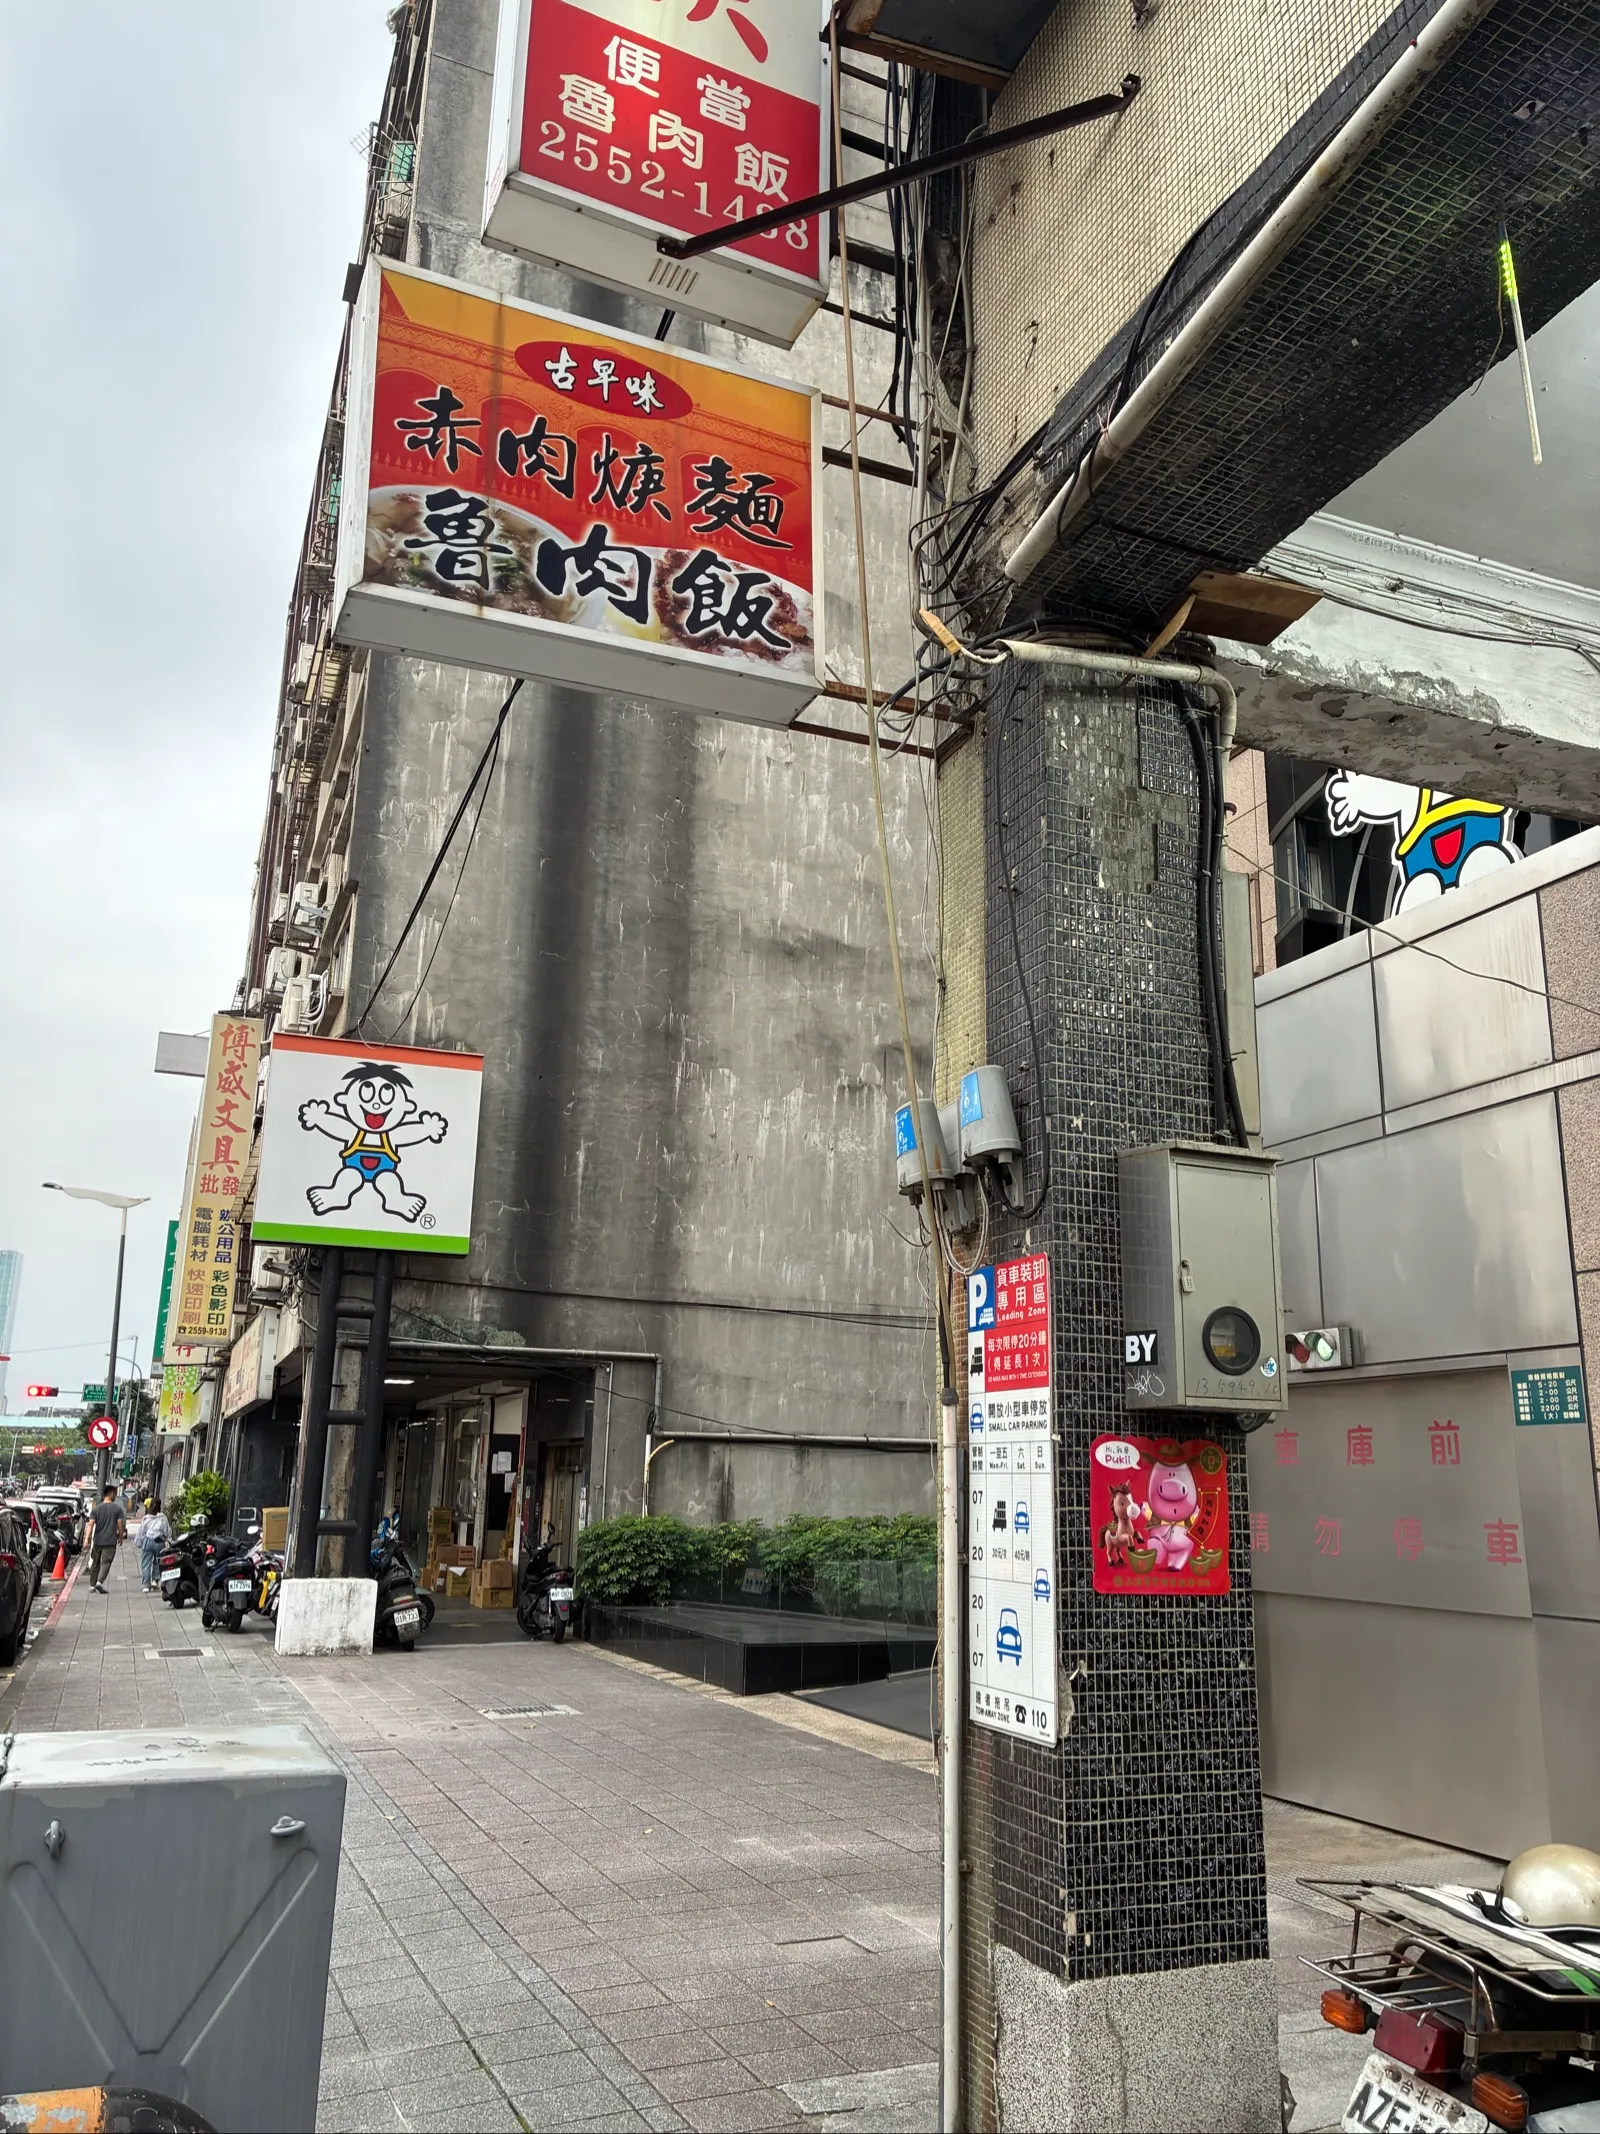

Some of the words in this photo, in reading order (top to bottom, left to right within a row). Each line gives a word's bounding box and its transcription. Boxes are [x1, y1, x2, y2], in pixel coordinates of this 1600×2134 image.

[603, 36, 751, 131] 便當
[559, 73, 790, 203] 魯肉飯
[545, 346, 665, 415] 古早味
[404, 488, 792, 648] 魯肉飯
[202, 1022, 257, 1173] 博威文具
[201, 1174, 240, 1196] 批發
[190, 1207, 213, 1263] 電腦耗材
[997, 1259, 1045, 1288] 貨車裝卸
[182, 1268, 206, 1325] 快速印刷
[207, 1270, 230, 1325] 彩色影印
[997, 1283, 1045, 1311] 專用區
[997, 1308, 1024, 1322] Loading
[1028, 1306, 1046, 1317] Zone
[188, 1327, 227, 1336] 2559-9138
[988, 1331, 1046, 1352] 每次限停20分鐘
[1125, 1334, 1156, 1363] BY
[988, 1400, 1047, 1418] 開放小型車停放
[989, 1422, 1007, 1432] SMALL
[1009, 1421, 1020, 1431] CAR
[1022, 1420, 1047, 1430] PARKING
[990, 1447, 1008, 1459] 一至五
[1018, 1447, 1024, 1459] 六
[1274, 1419, 1461, 1467] 車庫前
[972, 1490, 983, 1504] 07
[972, 1546, 983, 1561] 20
[972, 1595, 984, 1610] 20
[973, 1652, 984, 1668] 07
[998, 1712, 1010, 1723] ZONE
[1032, 1709, 1047, 1729] 110
